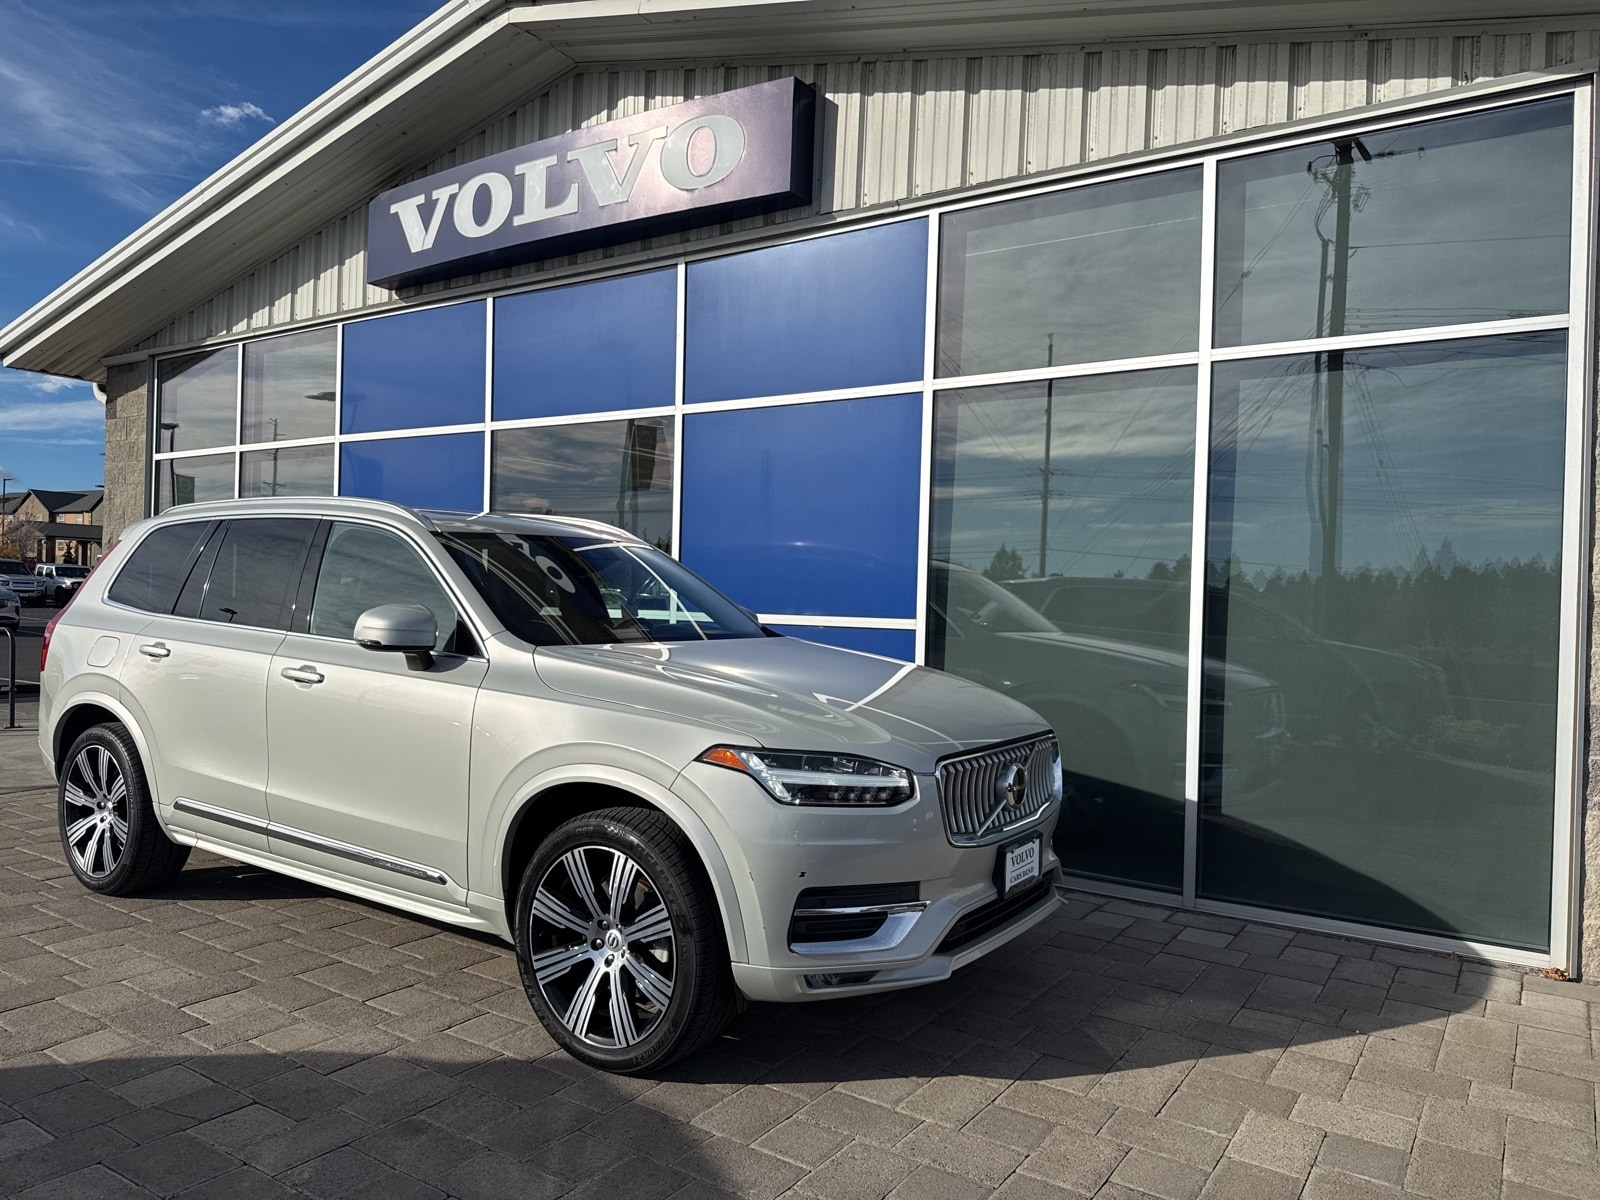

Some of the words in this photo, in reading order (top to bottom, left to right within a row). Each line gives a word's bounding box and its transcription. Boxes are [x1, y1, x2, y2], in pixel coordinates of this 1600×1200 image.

[390, 114, 746, 254] VOLVO
[1010, 846, 1035, 867] VOLVO
[1009, 873, 1022, 884] CARS
[1022, 866, 1035, 878] BEND
